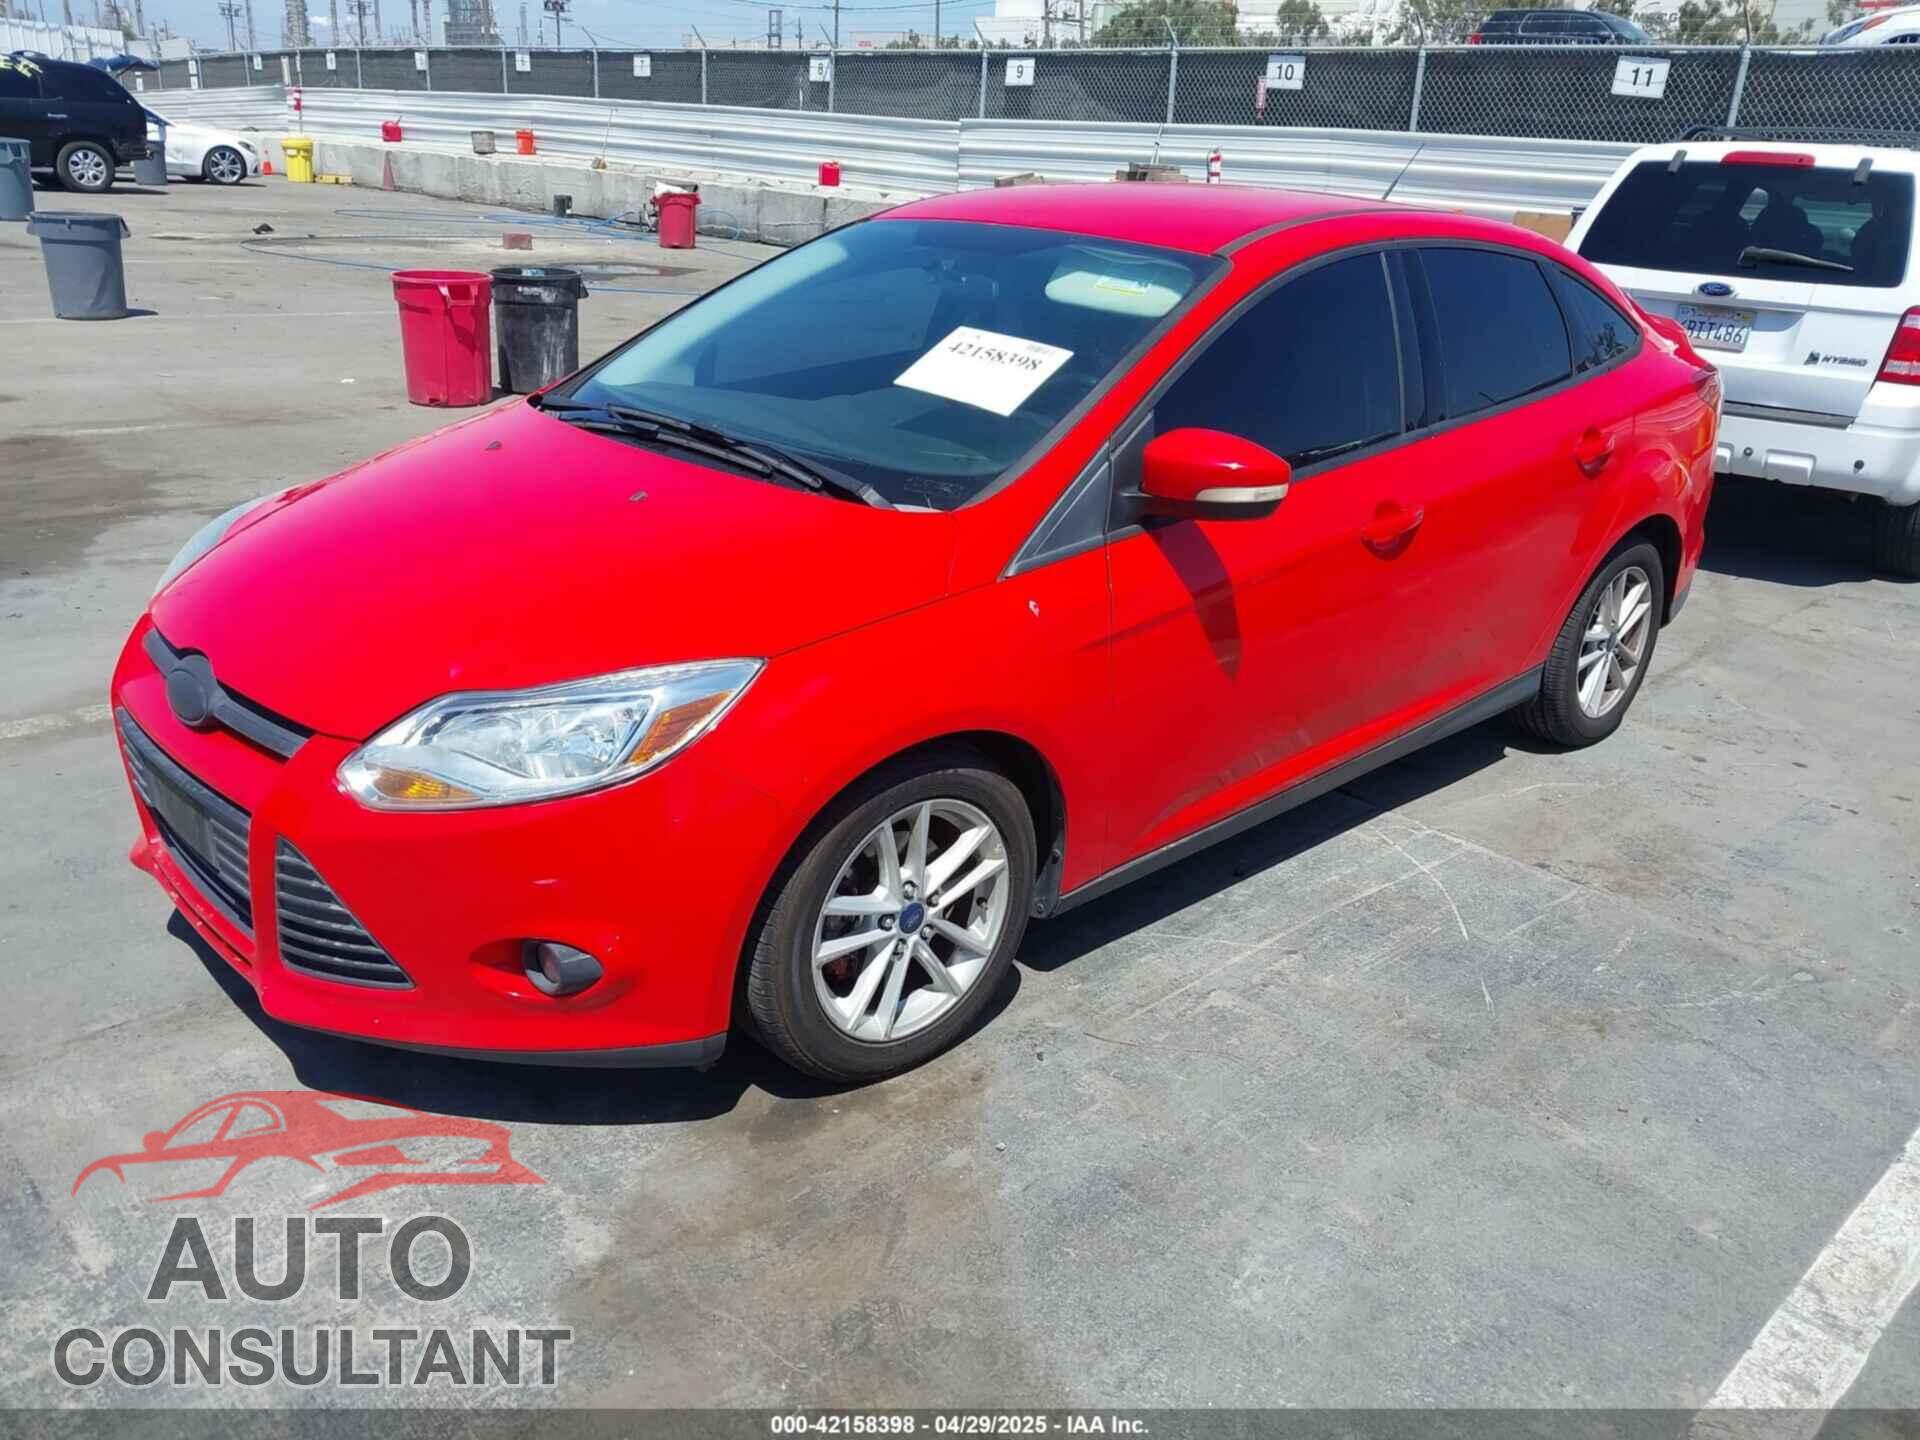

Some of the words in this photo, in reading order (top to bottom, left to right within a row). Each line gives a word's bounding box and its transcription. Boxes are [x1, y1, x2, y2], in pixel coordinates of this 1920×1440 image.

[1016, 64, 1024, 79] 9
[1276, 63, 1295, 81] 10
[1631, 67, 1654, 87] 11
[948, 342, 1043, 370] 42158398
